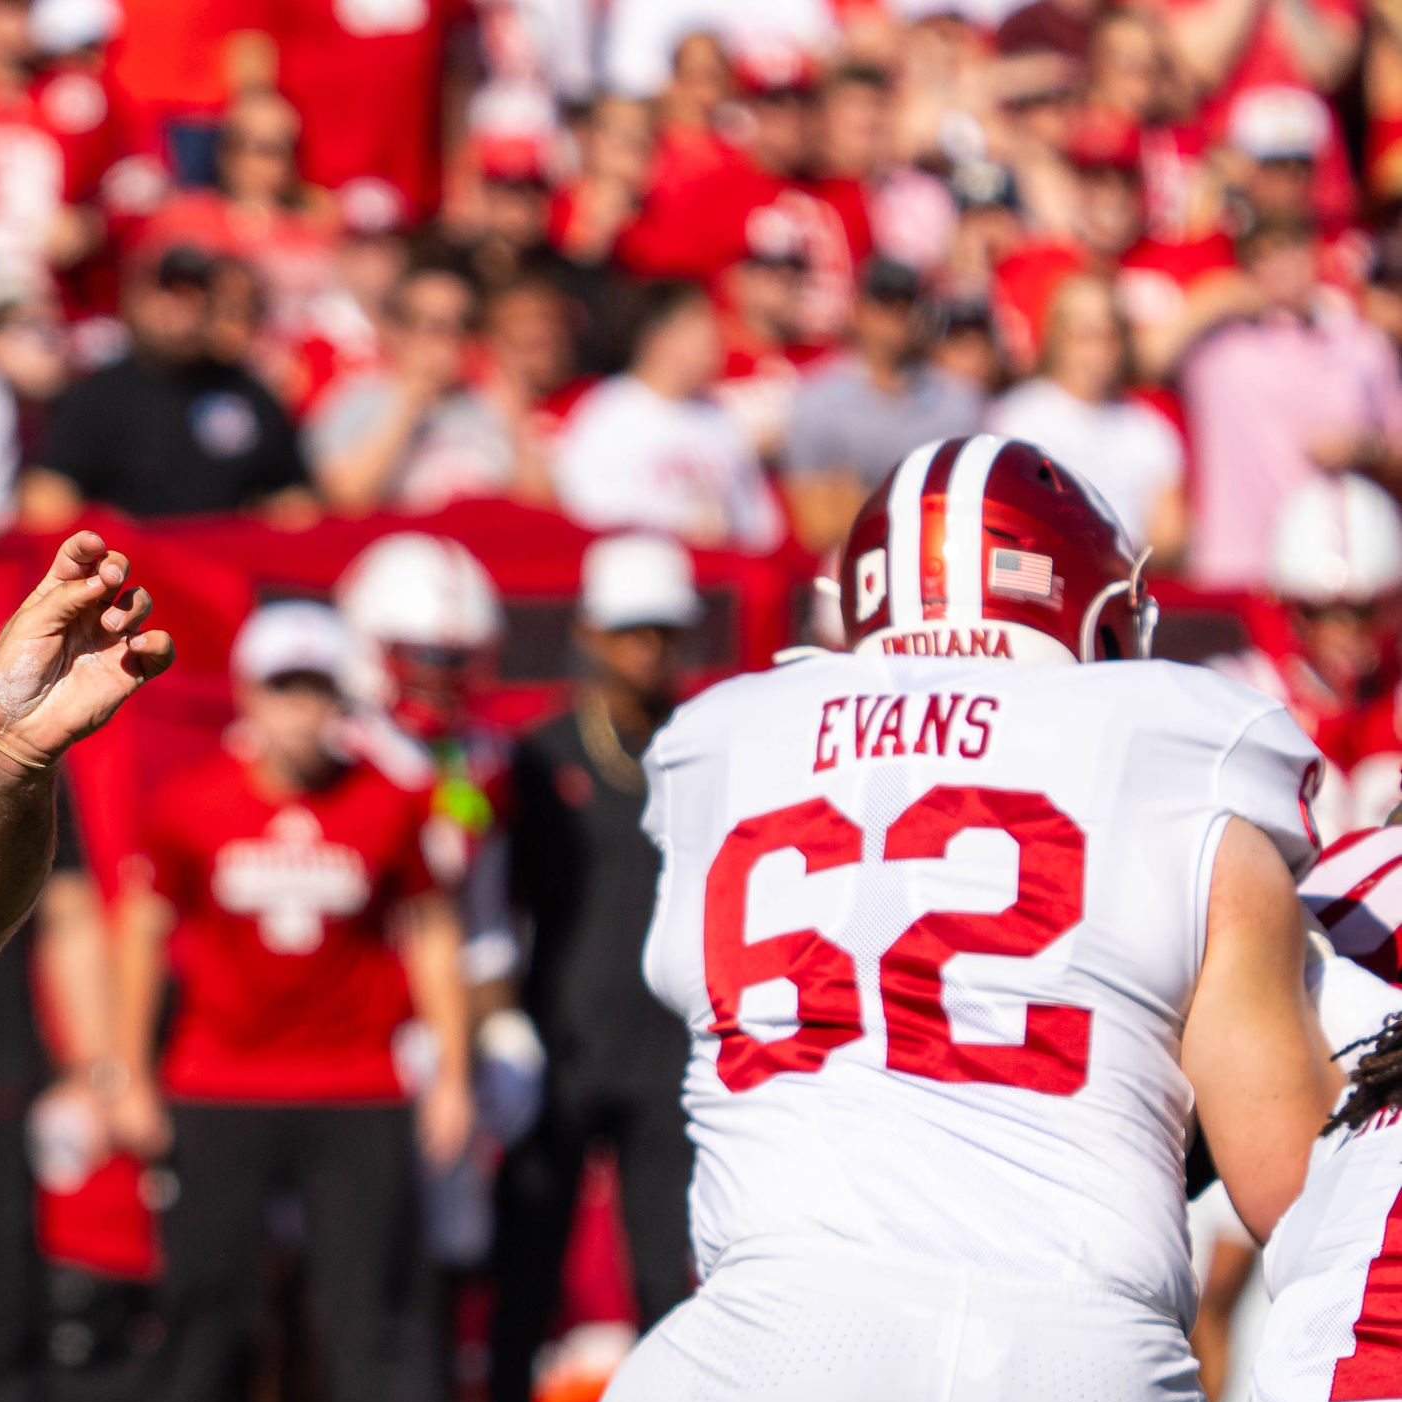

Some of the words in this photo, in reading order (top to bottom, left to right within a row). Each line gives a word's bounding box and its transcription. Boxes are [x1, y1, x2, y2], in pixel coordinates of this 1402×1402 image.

[882, 628, 1013, 660] INDIANA
[813, 693, 1001, 775] EVANS
[703, 784, 1095, 1098] 62
